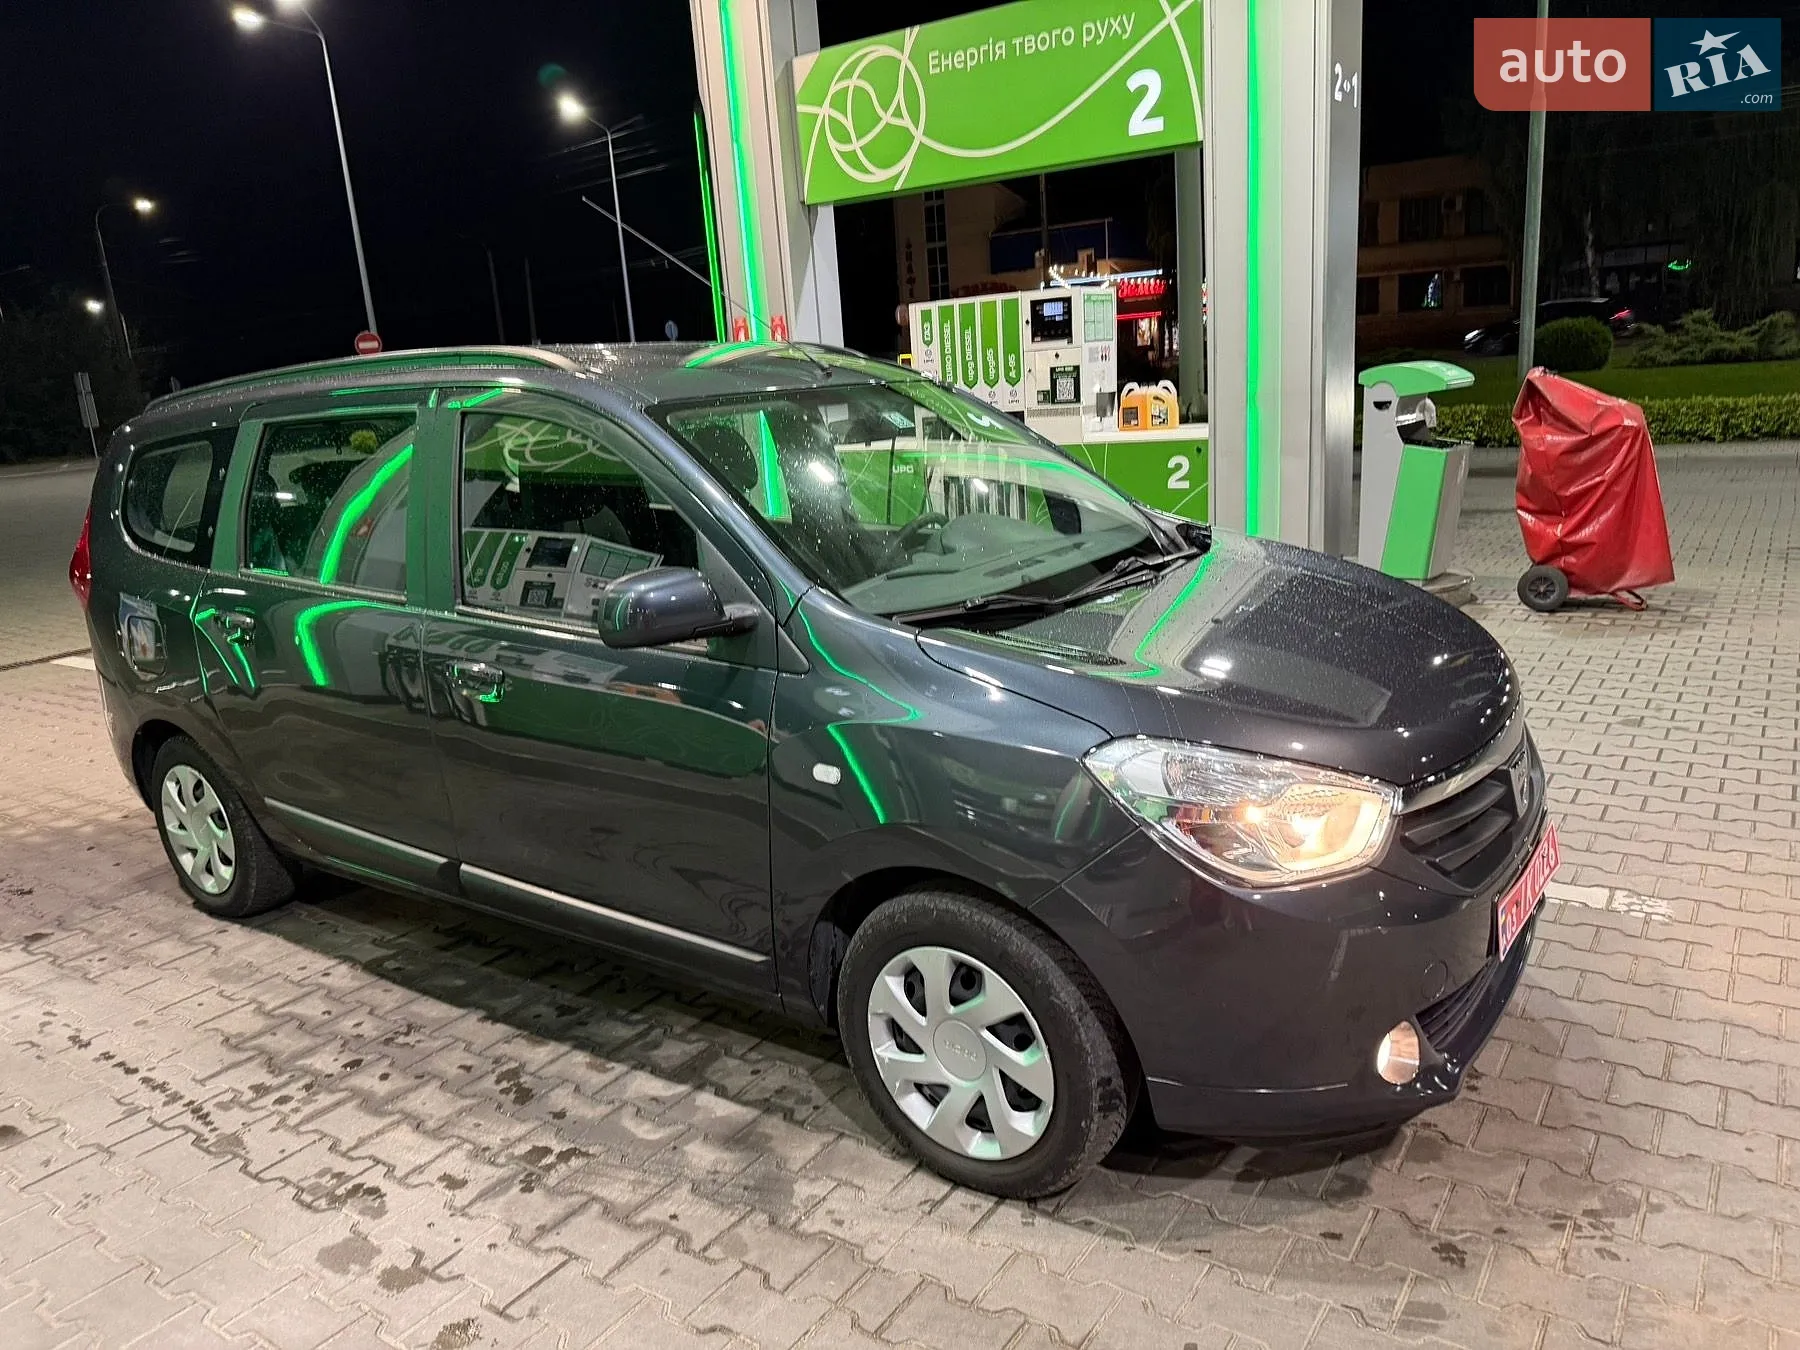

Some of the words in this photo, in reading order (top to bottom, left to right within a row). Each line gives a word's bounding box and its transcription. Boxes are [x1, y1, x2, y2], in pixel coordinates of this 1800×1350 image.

[928, 37, 1006, 75] Енергія
[1012, 26, 1075, 57] твого
[1082, 12, 1136, 47] руху
[1126, 68, 1165, 137] 2
[943, 319, 951, 354] DIESEL
[965, 325, 973, 360] DIESEL
[945, 355, 953, 382] EURO
[1167, 455, 1190, 489] 2
